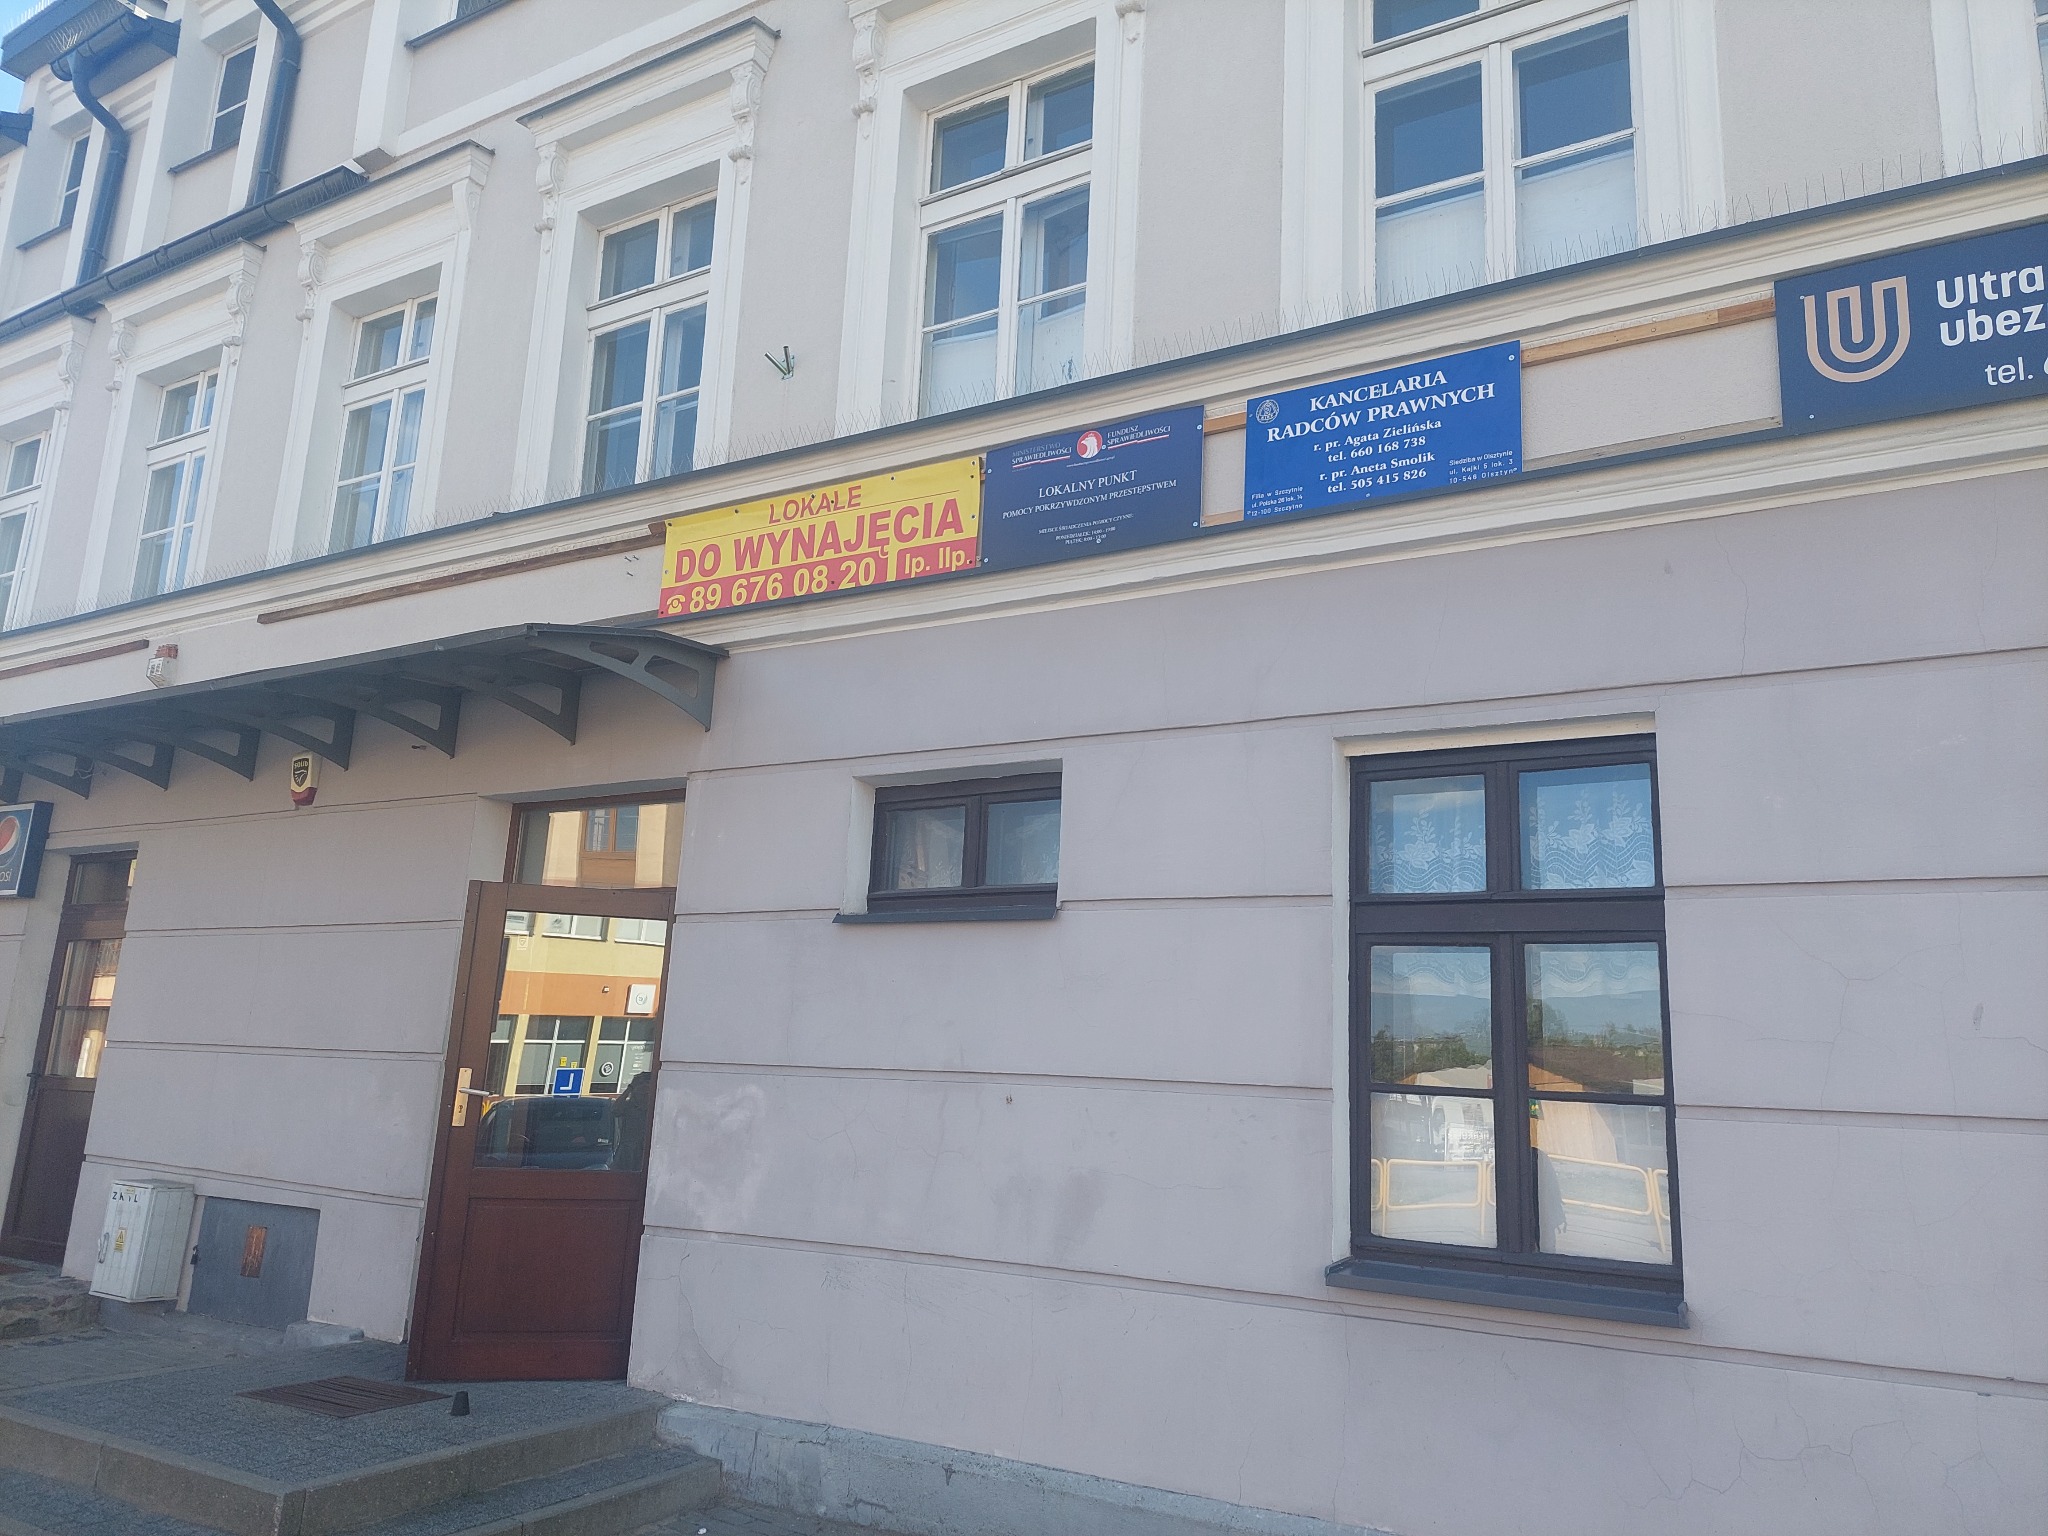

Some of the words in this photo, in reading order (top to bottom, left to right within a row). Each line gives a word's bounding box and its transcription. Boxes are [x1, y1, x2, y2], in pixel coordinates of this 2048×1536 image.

[1936, 266, 2045, 308] Ultra
[1985, 356, 2034, 386] tel.
[1310, 370, 1448, 412] KANCELARIA
[1267, 408, 1358, 442] RADCÓW
[1368, 382, 1495, 423] PRAWNYCH
[1107, 425, 1138, 438] FUNDUSZ
[1107, 426, 1171, 445] SPRAWIEDLIWOŚCI
[1314, 444, 1322, 452] r.
[1325, 440, 1340, 452] pr.
[1344, 431, 1379, 448] Agata
[1383, 419, 1442, 438] Zielińska
[1012, 447, 1072, 465] SPRAWIEDLIWOŚCI
[1328, 452, 1346, 462] tel.
[1350, 447, 1374, 459] 660
[1378, 441, 1399, 453] 168
[1404, 436, 1426, 448] 738
[1449, 457, 1476, 466] Siedziba
[1484, 450, 1513, 460] Olsztynie
[1319, 473, 1328, 481] r.
[1332, 469, 1347, 482] pr.
[1351, 461, 1386, 476] Aneta
[1391, 451, 1435, 469] Smolik
[1328, 482, 1346, 494] tel.
[1350, 477, 1373, 489] 505
[1377, 472, 1399, 485] 415
[1403, 468, 1426, 480] 826
[1462, 465, 1480, 473] Kajki
[1482, 468, 1513, 478] Olsztyn
[1039, 479, 1095, 498] LOKALNY
[1098, 470, 1137, 488] PUNKT
[769, 485, 862, 524] LOKALE
[1003, 507, 1033, 519] POMOCY
[1035, 494, 1107, 513] POKRZYWDZONYM
[1109, 480, 1177, 500] PRZESTĘPSTWEM
[1252, 508, 1271, 516] 12-100
[1274, 504, 1302, 512] Szczytno
[675, 544, 721, 583] DO
[733, 498, 964, 571] WYNAJĘCIA
[689, 584, 722, 614] 89
[731, 572, 783, 604] 676
[794, 565, 828, 595] 08
[838, 557, 876, 590] 20
